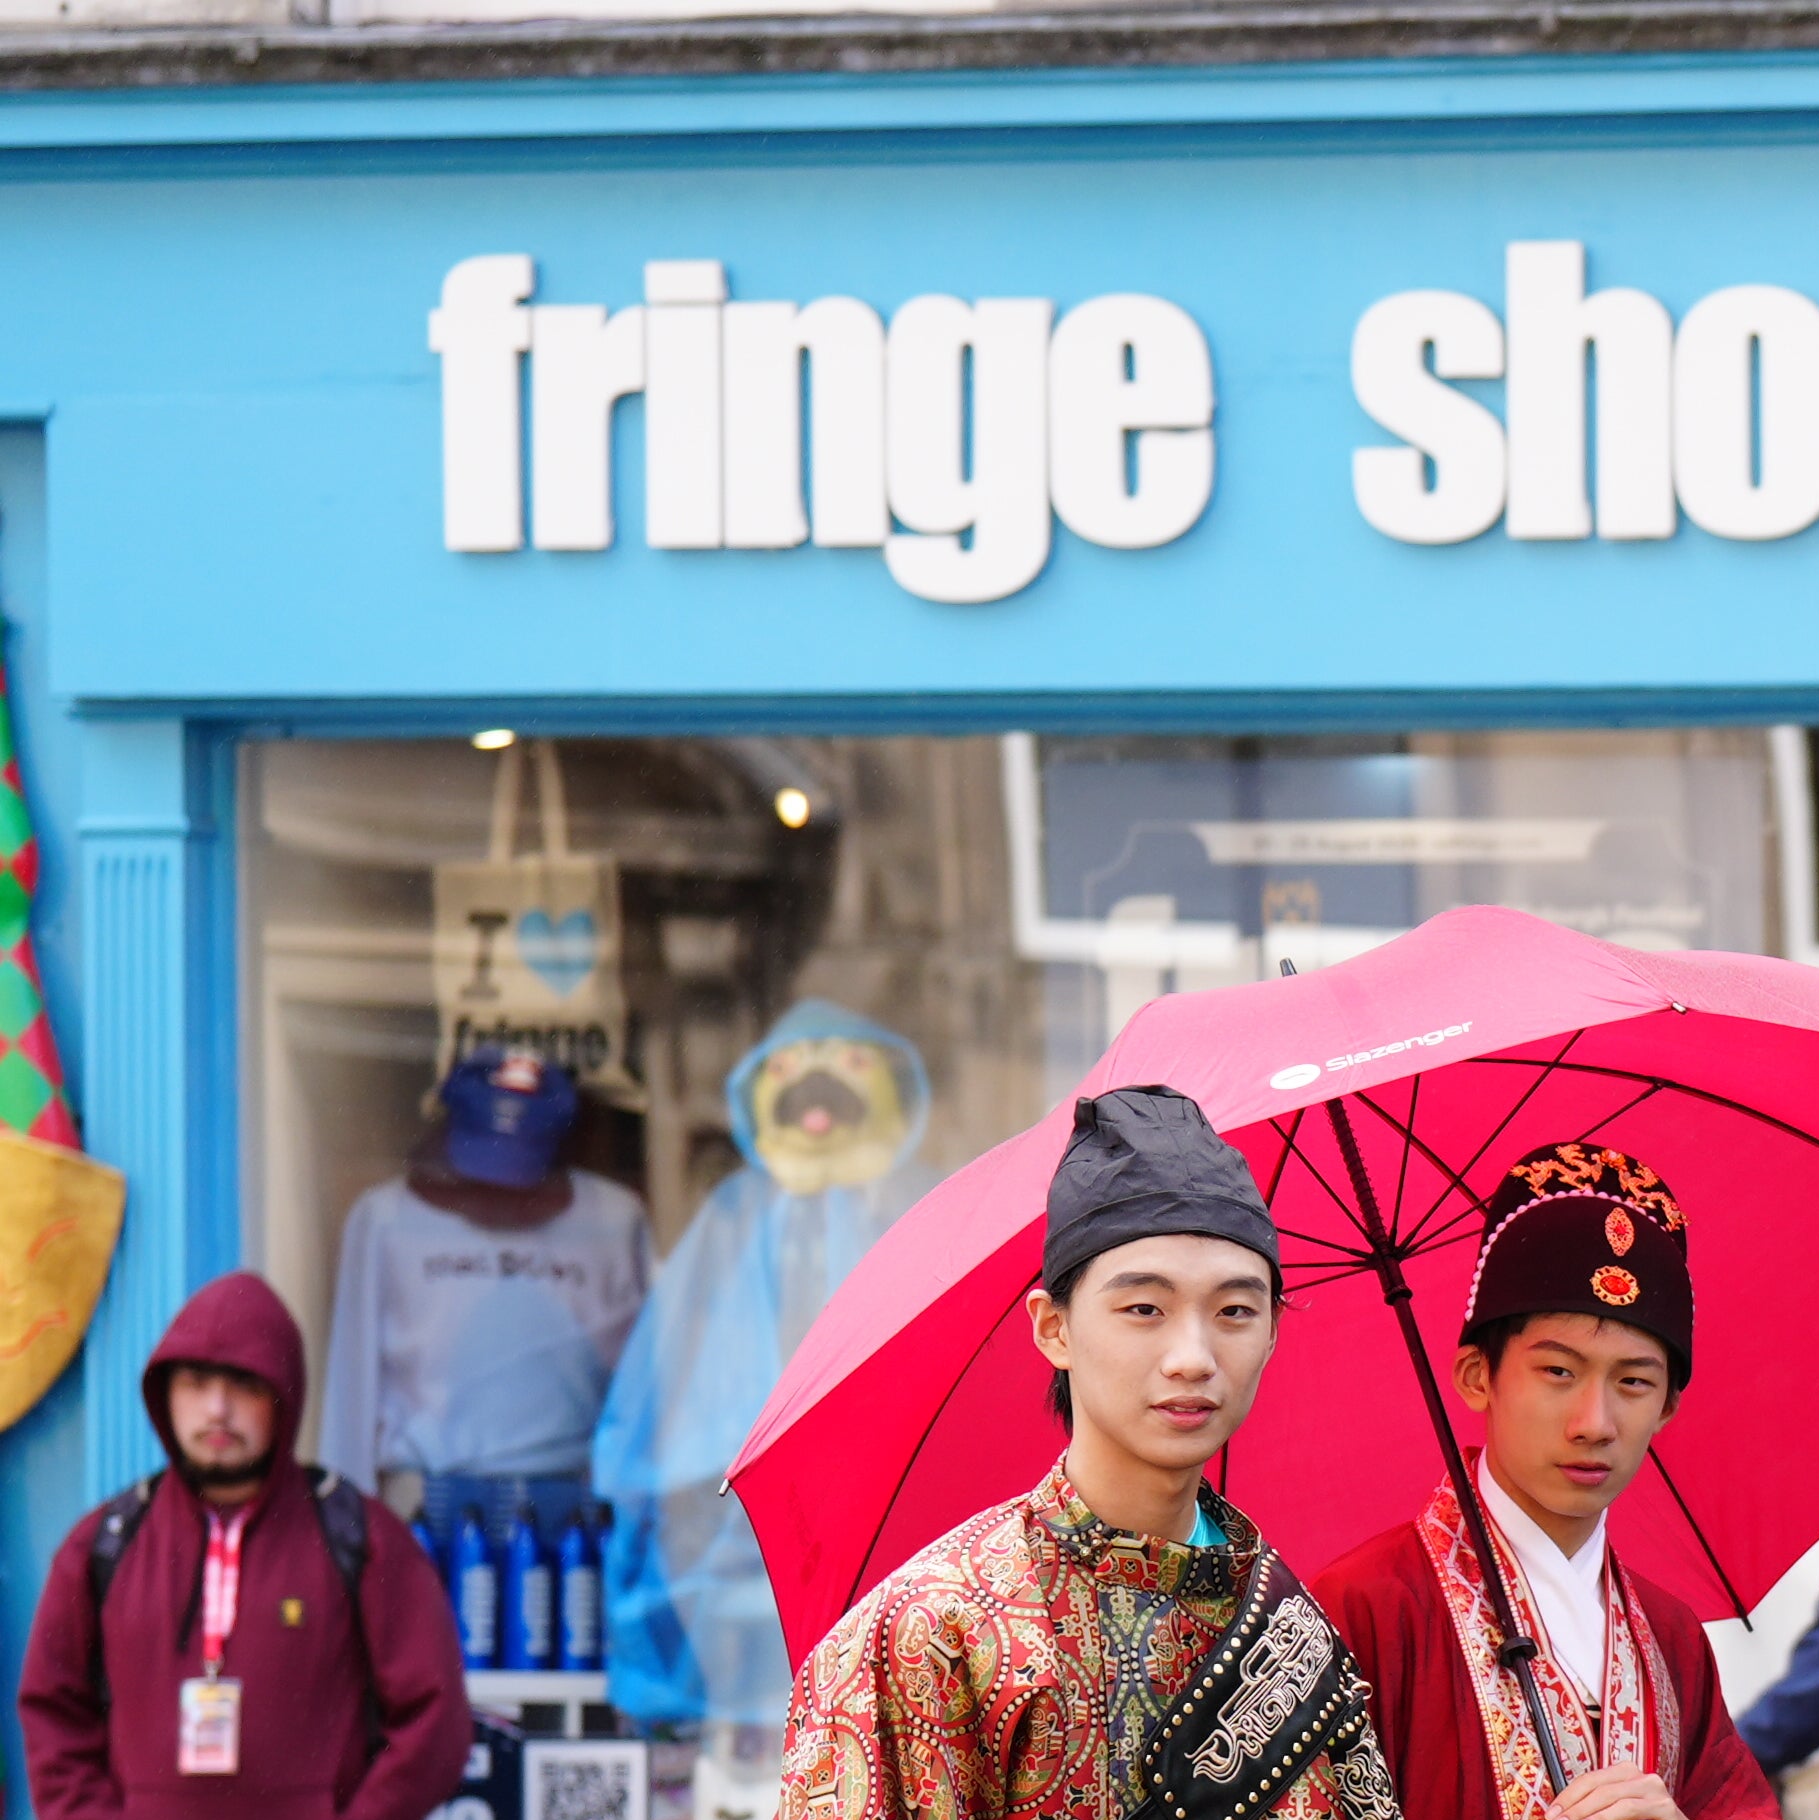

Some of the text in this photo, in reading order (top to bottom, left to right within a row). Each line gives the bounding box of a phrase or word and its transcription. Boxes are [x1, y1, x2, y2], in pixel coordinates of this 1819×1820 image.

[428, 254, 1214, 603] fringe
[459, 912, 510, 997] I
[1325, 1020, 1473, 1072] Slazenger
